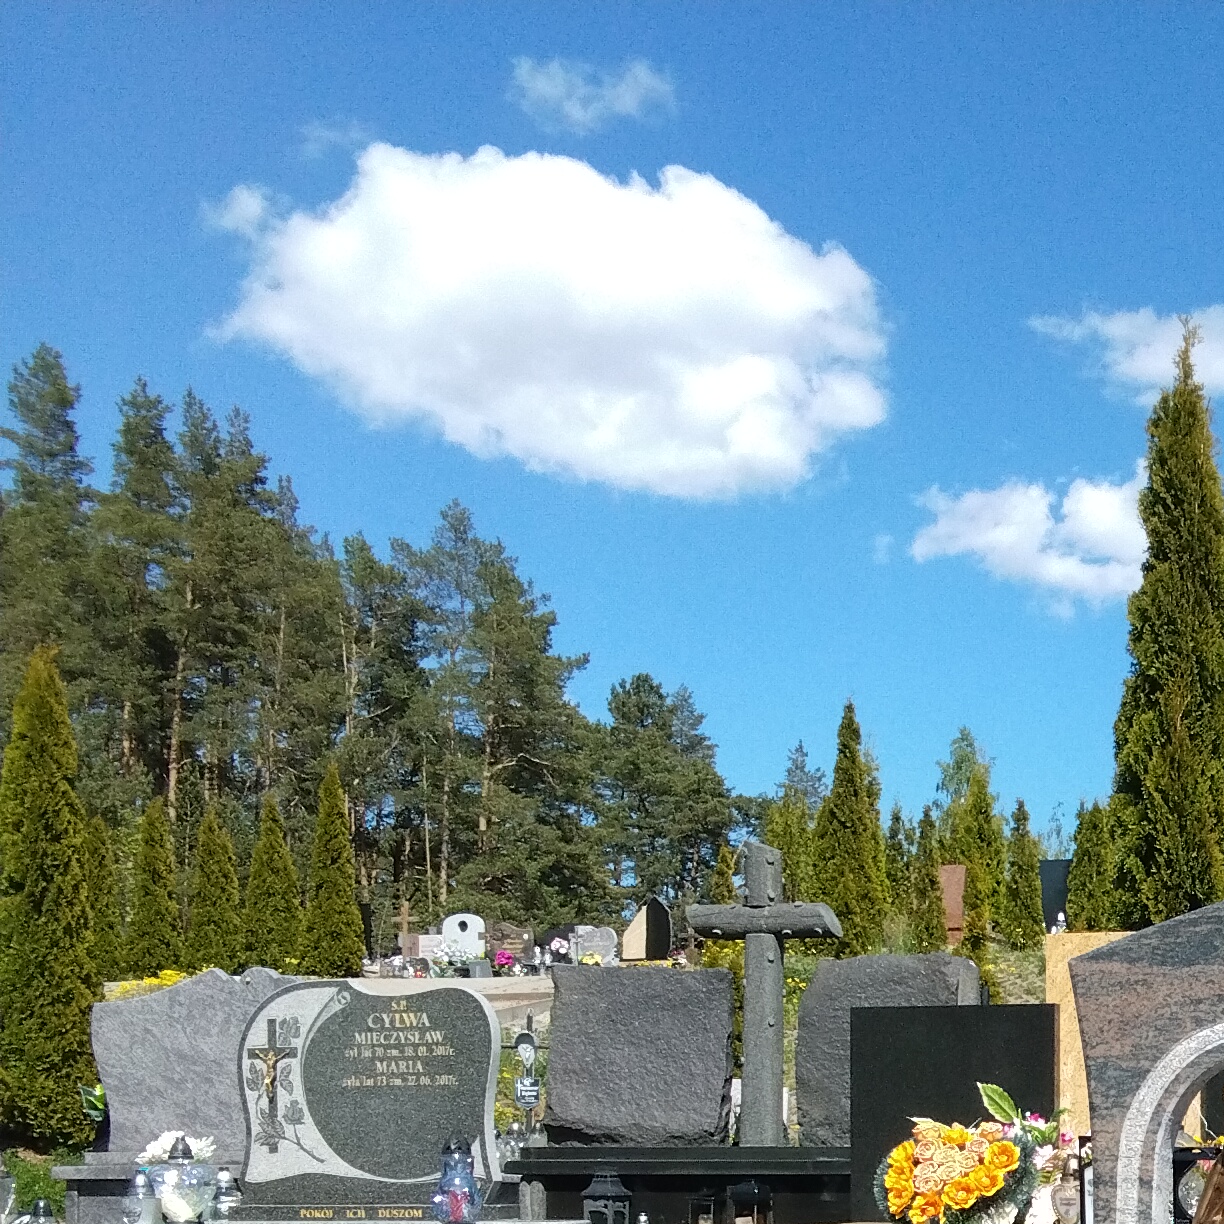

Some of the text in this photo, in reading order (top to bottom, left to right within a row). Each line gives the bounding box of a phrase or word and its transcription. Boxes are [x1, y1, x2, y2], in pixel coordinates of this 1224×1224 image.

[367, 1012, 431, 1029] CYLWA
[354, 1031, 445, 1044] MIECZYSŁAW
[375, 1060, 424, 1073] MARIA
[346, 1208, 366, 1218] ICH
[377, 1208, 423, 1218] DUSZOM
